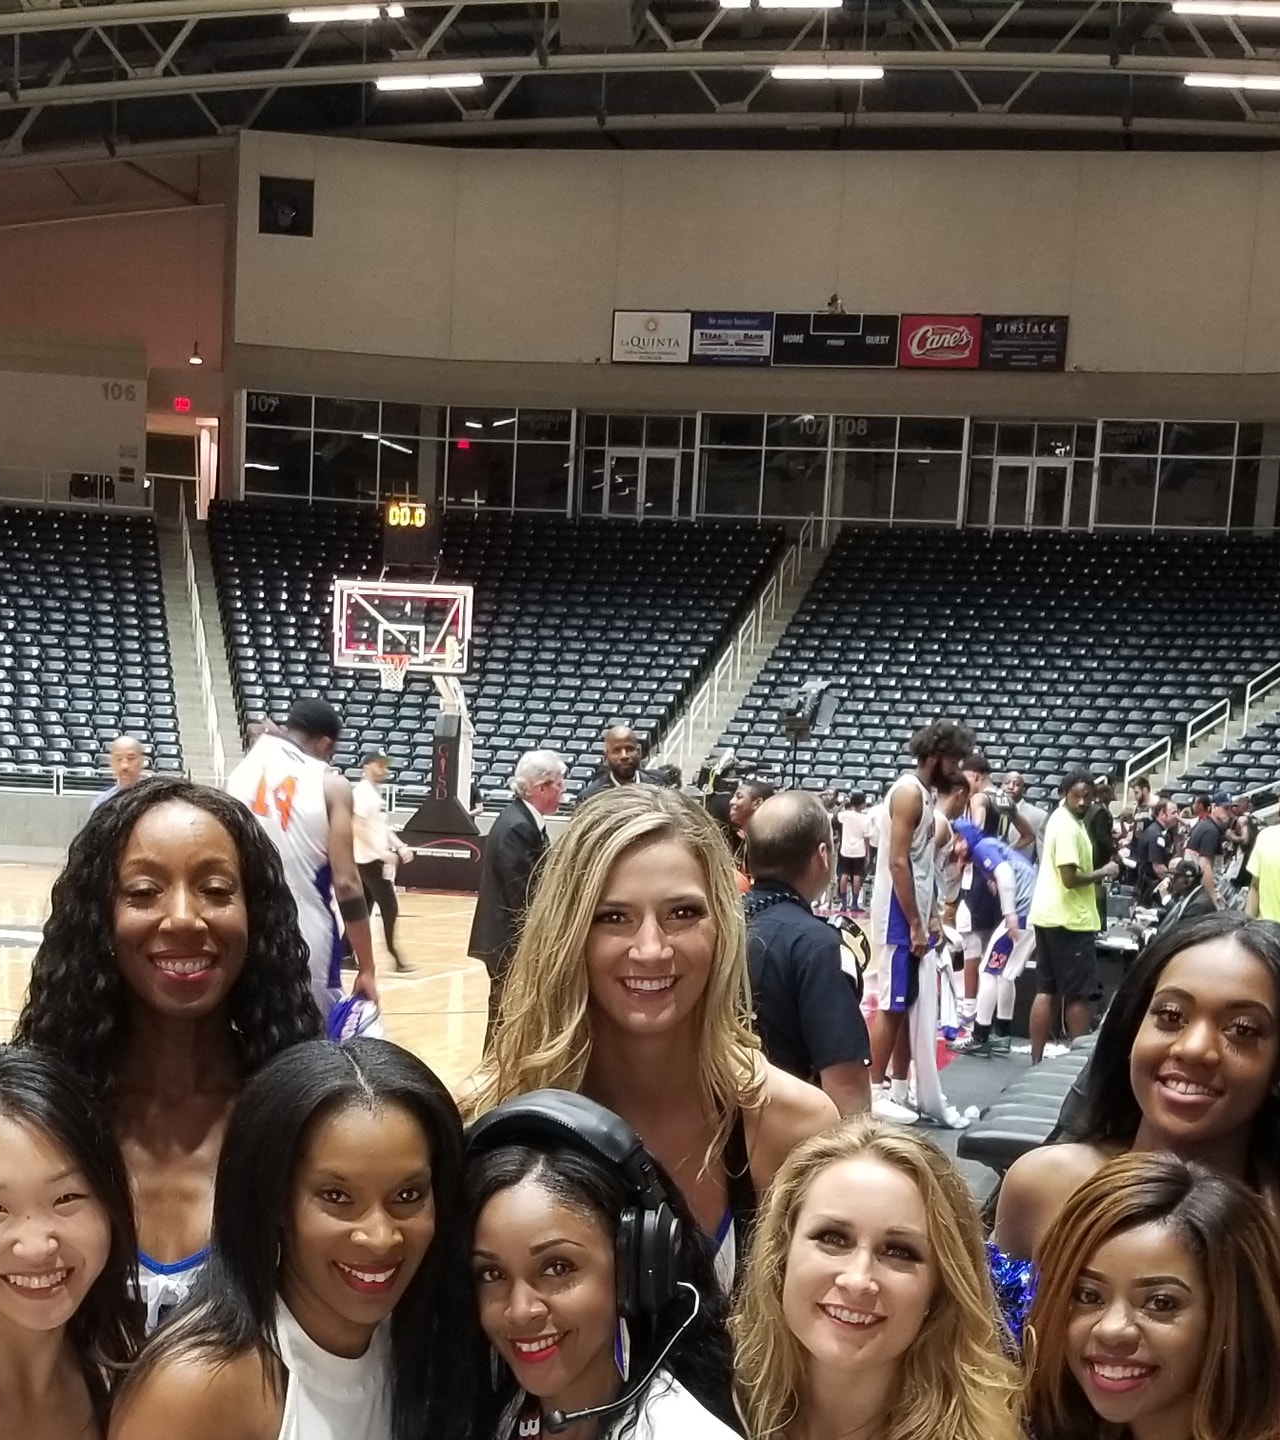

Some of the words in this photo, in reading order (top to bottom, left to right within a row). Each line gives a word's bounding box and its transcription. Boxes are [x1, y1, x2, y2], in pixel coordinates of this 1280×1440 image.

[995, 322, 1056, 334] PINSTACK
[630, 335, 681, 348] QUINTA
[783, 334, 804, 344] HOME
[865, 335, 890, 345] GUEST
[912, 325, 971, 356] Cane's
[101, 382, 136, 401] 106
[836, 418, 867, 435] 108
[388, 507, 426, 528] 00.0
[250, 768, 296, 832] 14
